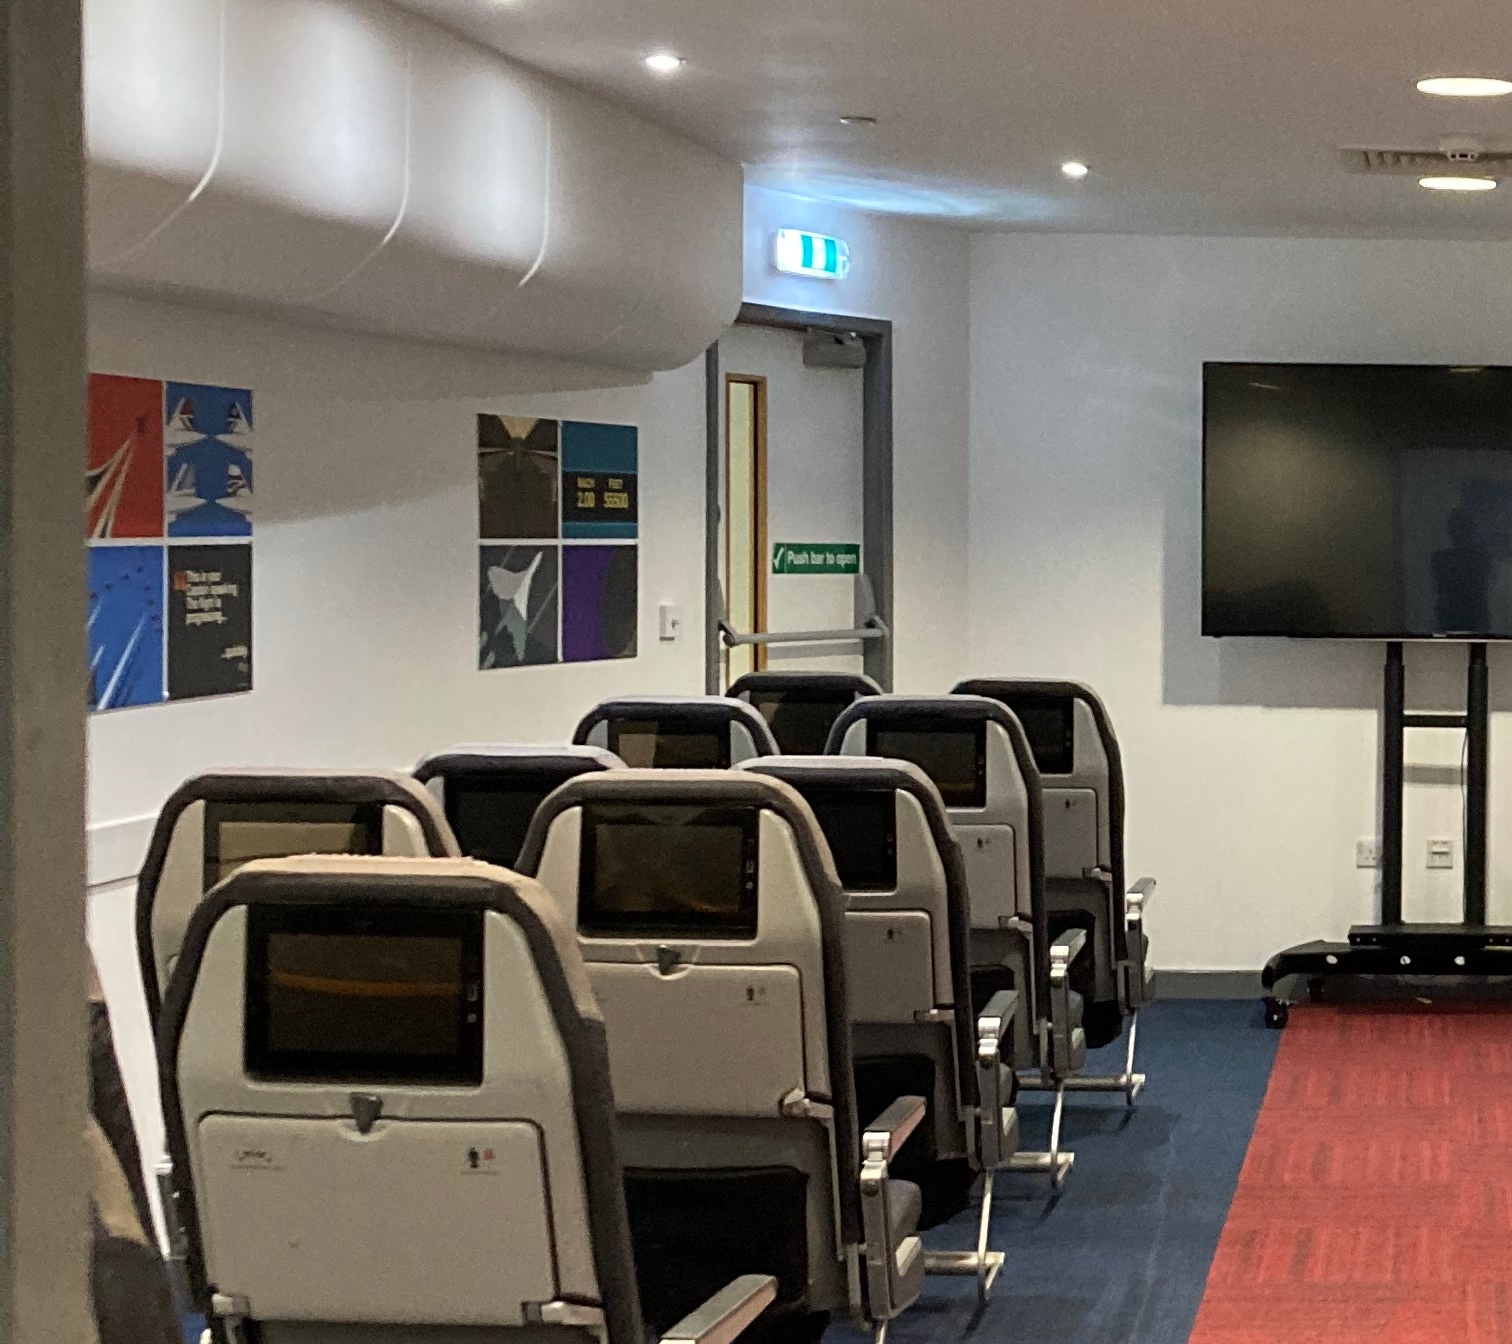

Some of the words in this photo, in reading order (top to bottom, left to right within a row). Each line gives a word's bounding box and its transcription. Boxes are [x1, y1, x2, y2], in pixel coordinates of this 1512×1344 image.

[787, 550, 809, 565] Push
[810, 550, 825, 565] bar
[825, 550, 835, 565] to
[836, 553, 857, 568] open
